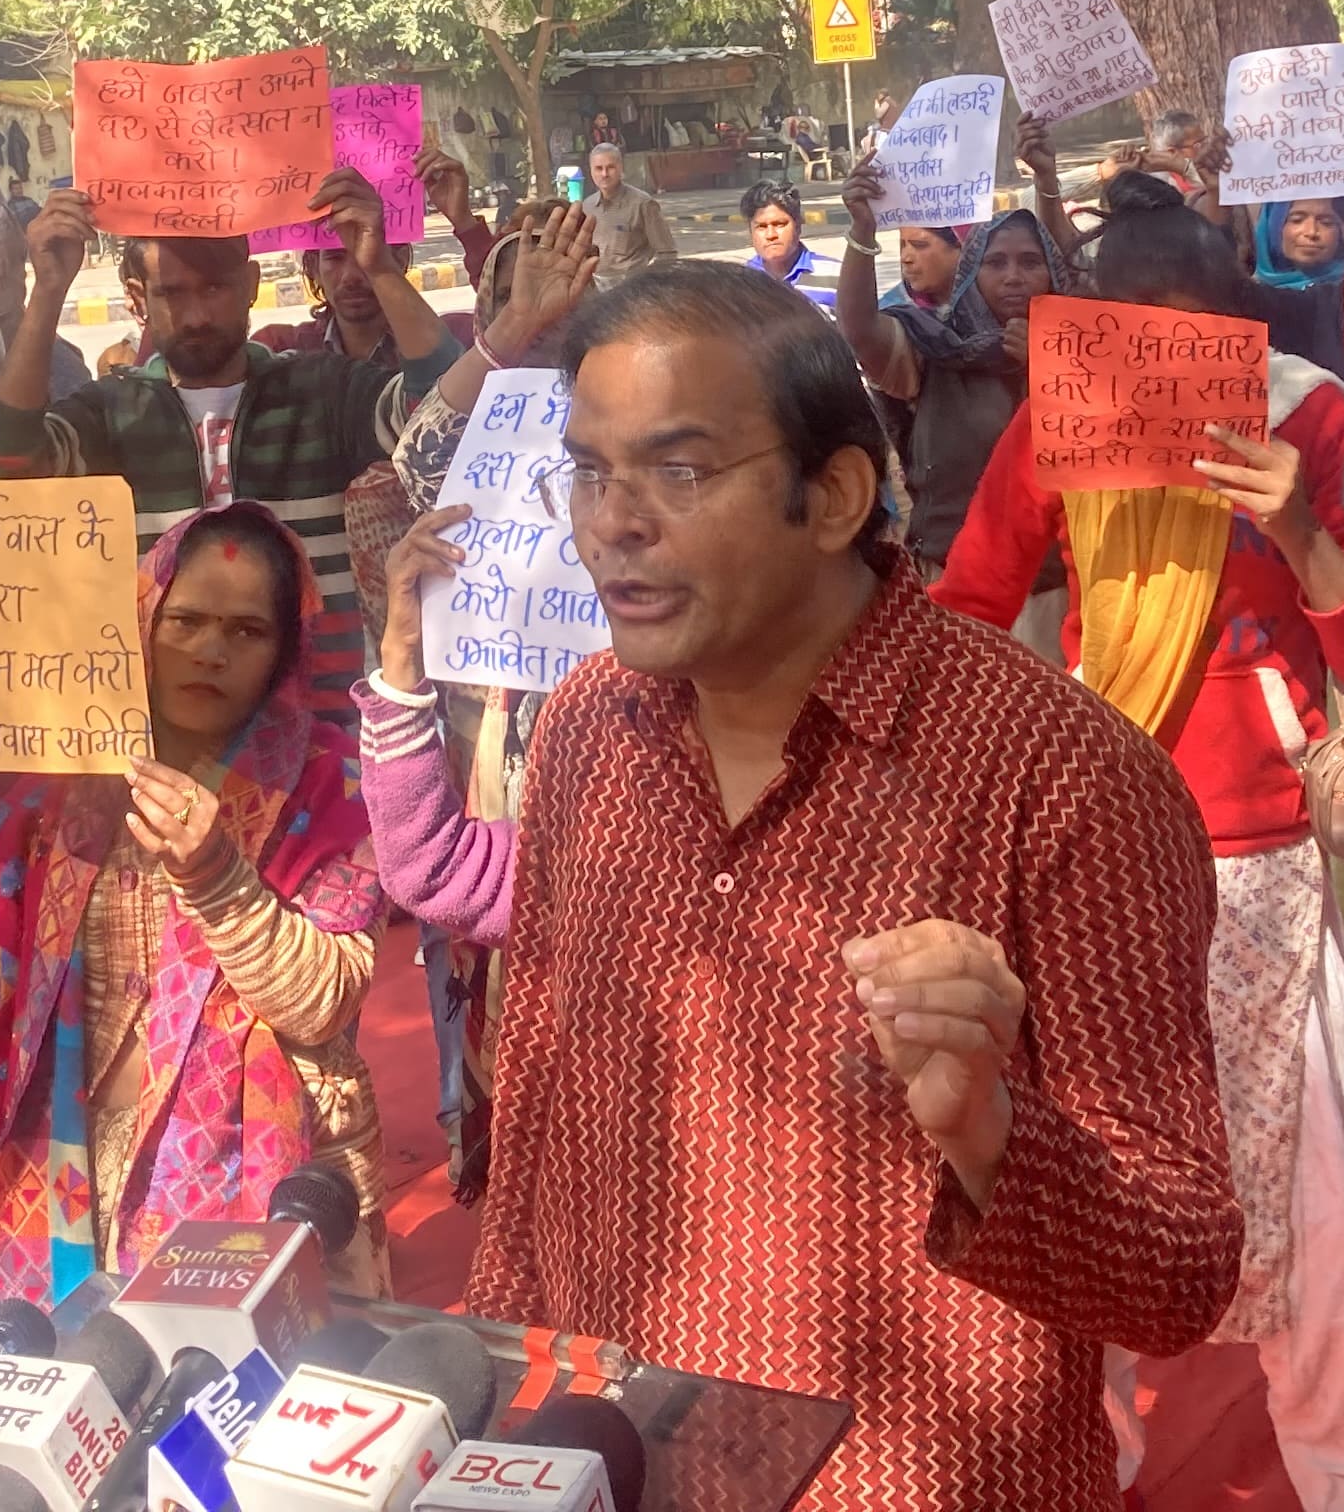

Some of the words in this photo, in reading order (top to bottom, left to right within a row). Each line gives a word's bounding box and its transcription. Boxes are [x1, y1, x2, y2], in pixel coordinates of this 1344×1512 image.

[829, 33, 857, 43] CROSS
[832, 43, 855, 54] ROAD
[97, 113, 148, 140] घर
[155, 106, 188, 140] से
[1042, 313, 1120, 359] कोर्ट
[1131, 376, 1190, 406] हम
[483, 391, 540, 434] हम
[1040, 412, 1098, 439] घर
[75, 499, 115, 562] के
[21, 651, 74, 695] मत
[72, 623, 140, 695] करो
[151, 1244, 271, 1269] Sunrise
[162, 1268, 256, 1290] NEWS
[277, 1397, 341, 1429] LIVE
[344, 1459, 379, 1482] TV
[449, 1453, 562, 1491] BCL
[468, 1485, 501, 1496] NEWS
[501, 1486, 532, 1498] EXPO
